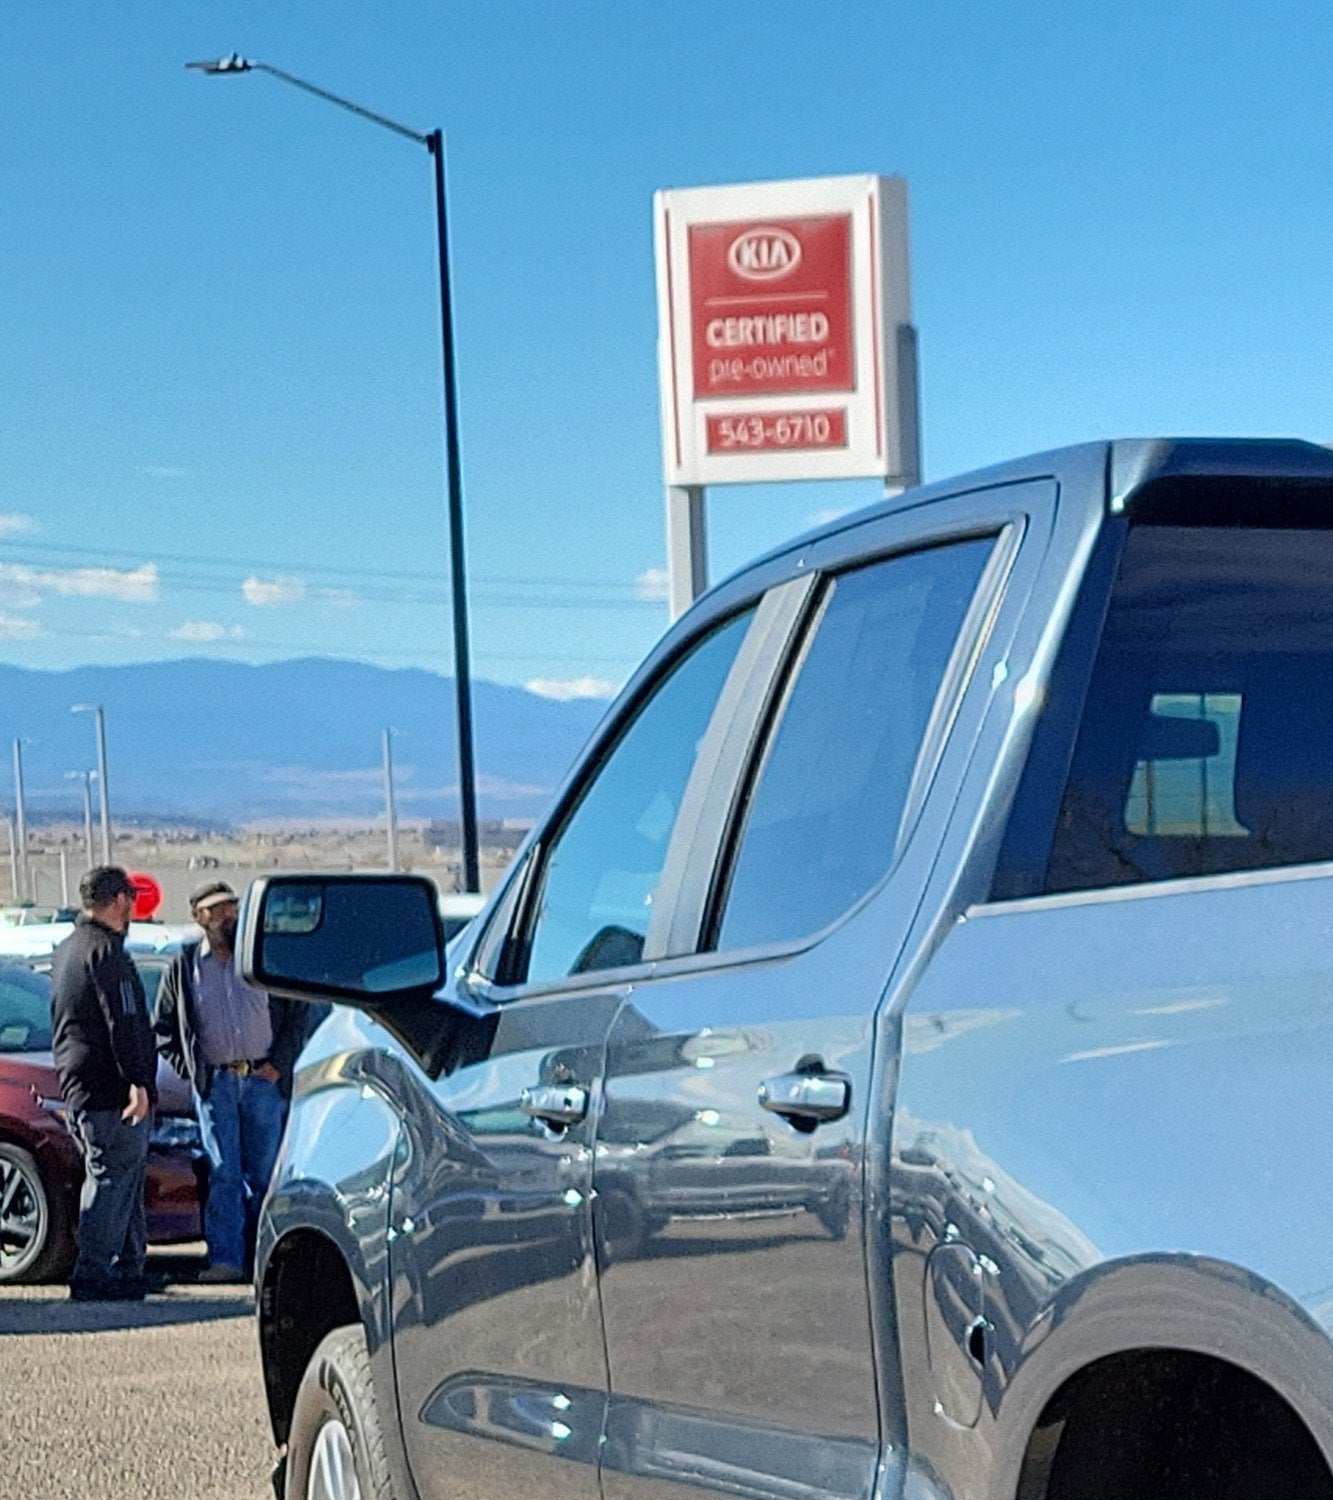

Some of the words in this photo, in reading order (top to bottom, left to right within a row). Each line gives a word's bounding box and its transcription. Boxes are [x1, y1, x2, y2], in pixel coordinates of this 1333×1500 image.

[739, 237, 791, 268] KIA
[706, 312, 830, 348] CERTIFIED
[710, 349, 828, 383] pre-owned
[719, 416, 830, 446] 543-6710
